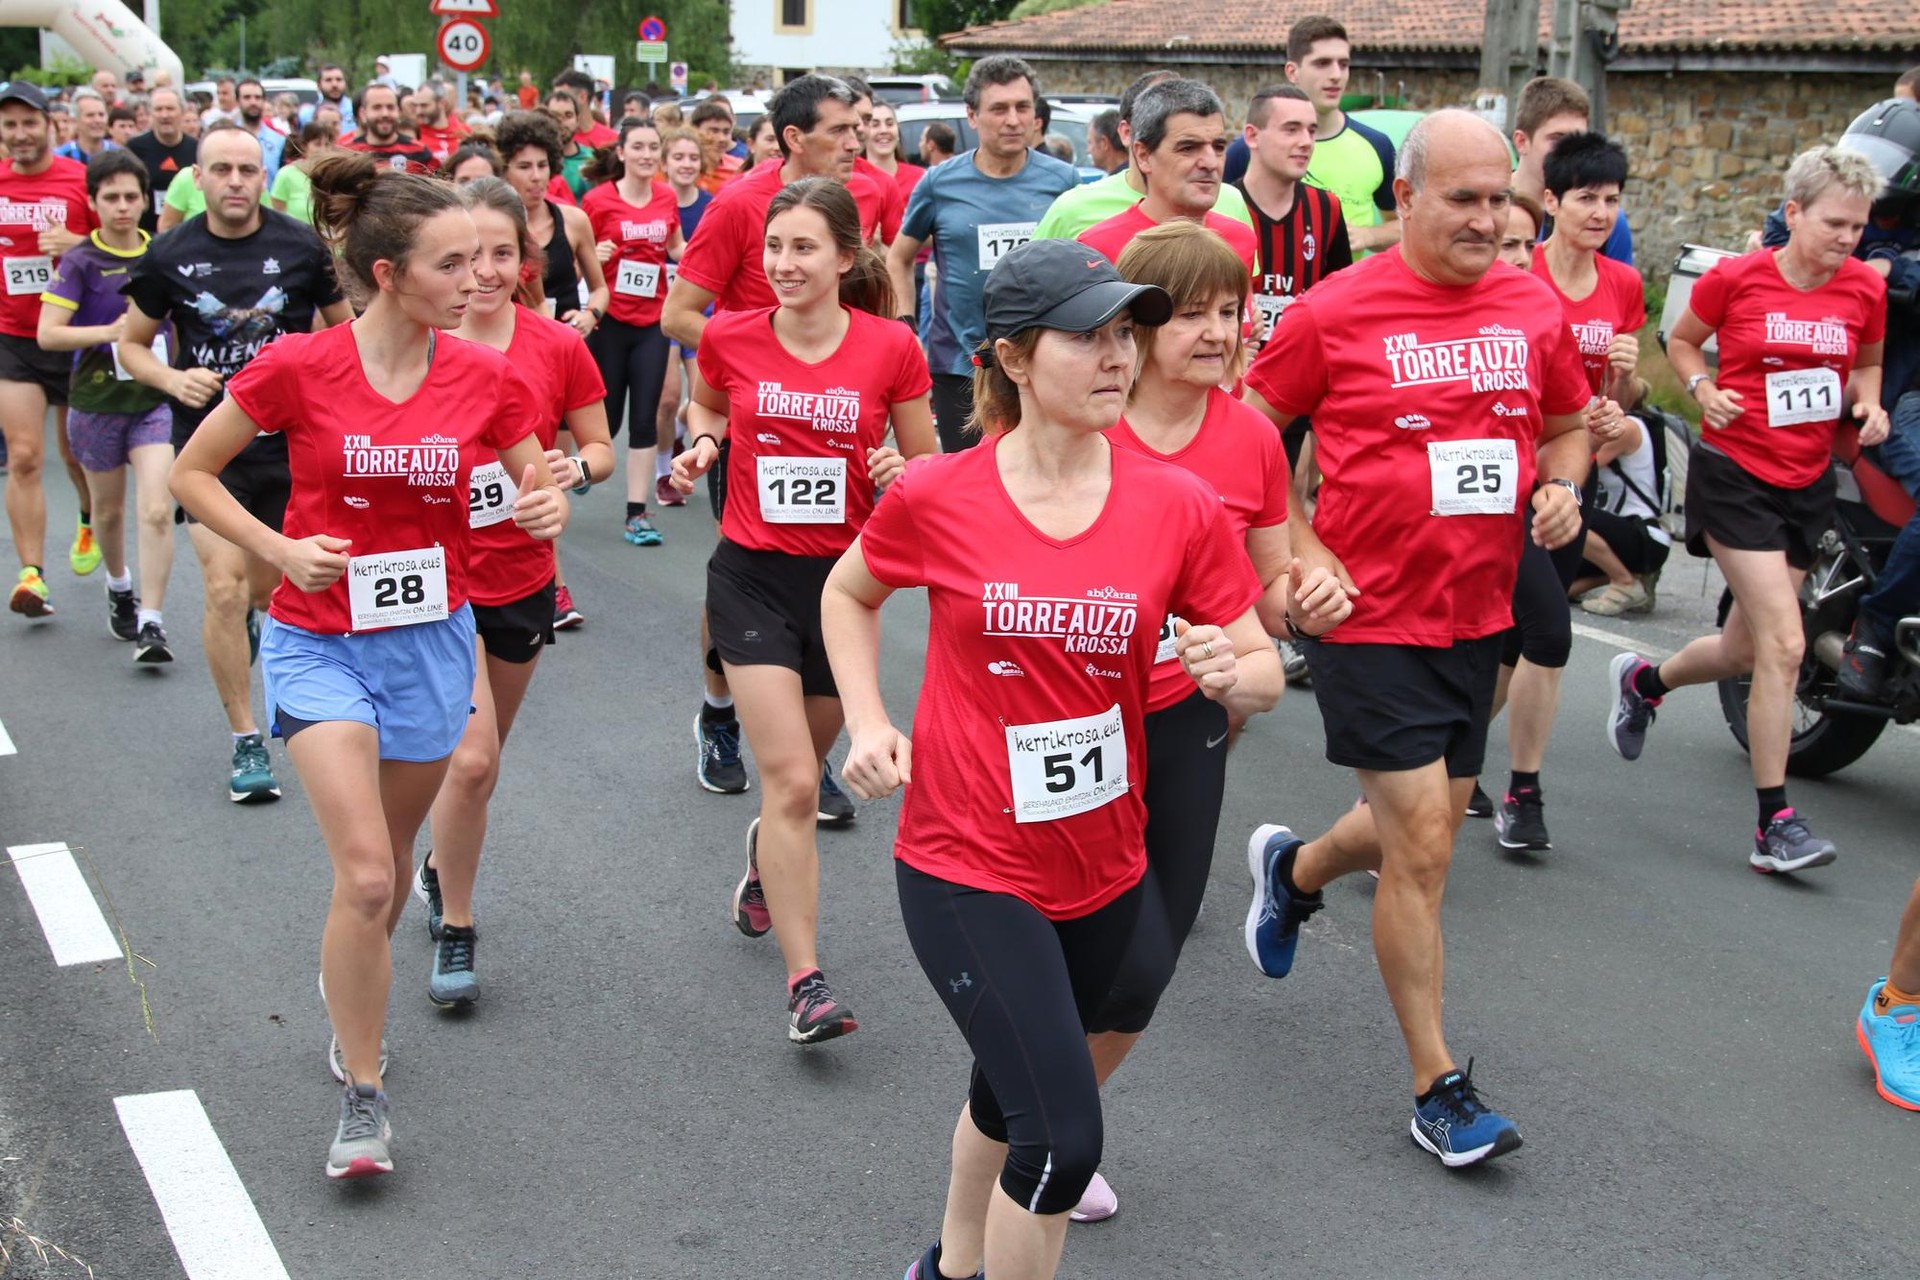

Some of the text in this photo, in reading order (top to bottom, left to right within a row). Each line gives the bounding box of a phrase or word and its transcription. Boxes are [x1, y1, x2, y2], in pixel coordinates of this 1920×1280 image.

[448, 36, 478, 51] 40
[987, 238, 1029, 257] 17
[11, 268, 49, 284] 219
[624, 272, 653, 288] 167
[1264, 273, 1293, 292] Fly
[1383, 332, 1418, 354] XXIII
[1765, 323, 1847, 344] TORREAUZO
[1385, 340, 1529, 383] TORREAUZO
[758, 381, 781, 393] XXIII
[1470, 369, 1529, 393] KROSSA
[757, 393, 860, 420] TORREAUZO
[1778, 385, 1831, 411] 111
[812, 417, 857, 434] KROSSA
[343, 434, 371, 449] XXIII
[343, 448, 459, 474] TORREAUZO
[762, 461, 842, 477] herrikrosa.eus
[408, 472, 456, 487] KROSSA
[1456, 464, 1501, 494] 25
[470, 482, 504, 512] 29
[768, 479, 836, 505] 122
[353, 557, 440, 577] herrikrosa.eus
[374, 574, 425, 608] 28
[983, 582, 1019, 600] XXIII
[983, 601, 1138, 637] TORREAUZO
[1064, 635, 1128, 655] KROSSA
[1095, 668, 1122, 679] LANA
[1014, 717, 1120, 752] herrikrosa.eus
[1043, 745, 1103, 793] 51
[1093, 785, 1106, 796] ON
[1107, 774, 1122, 790] LINE
